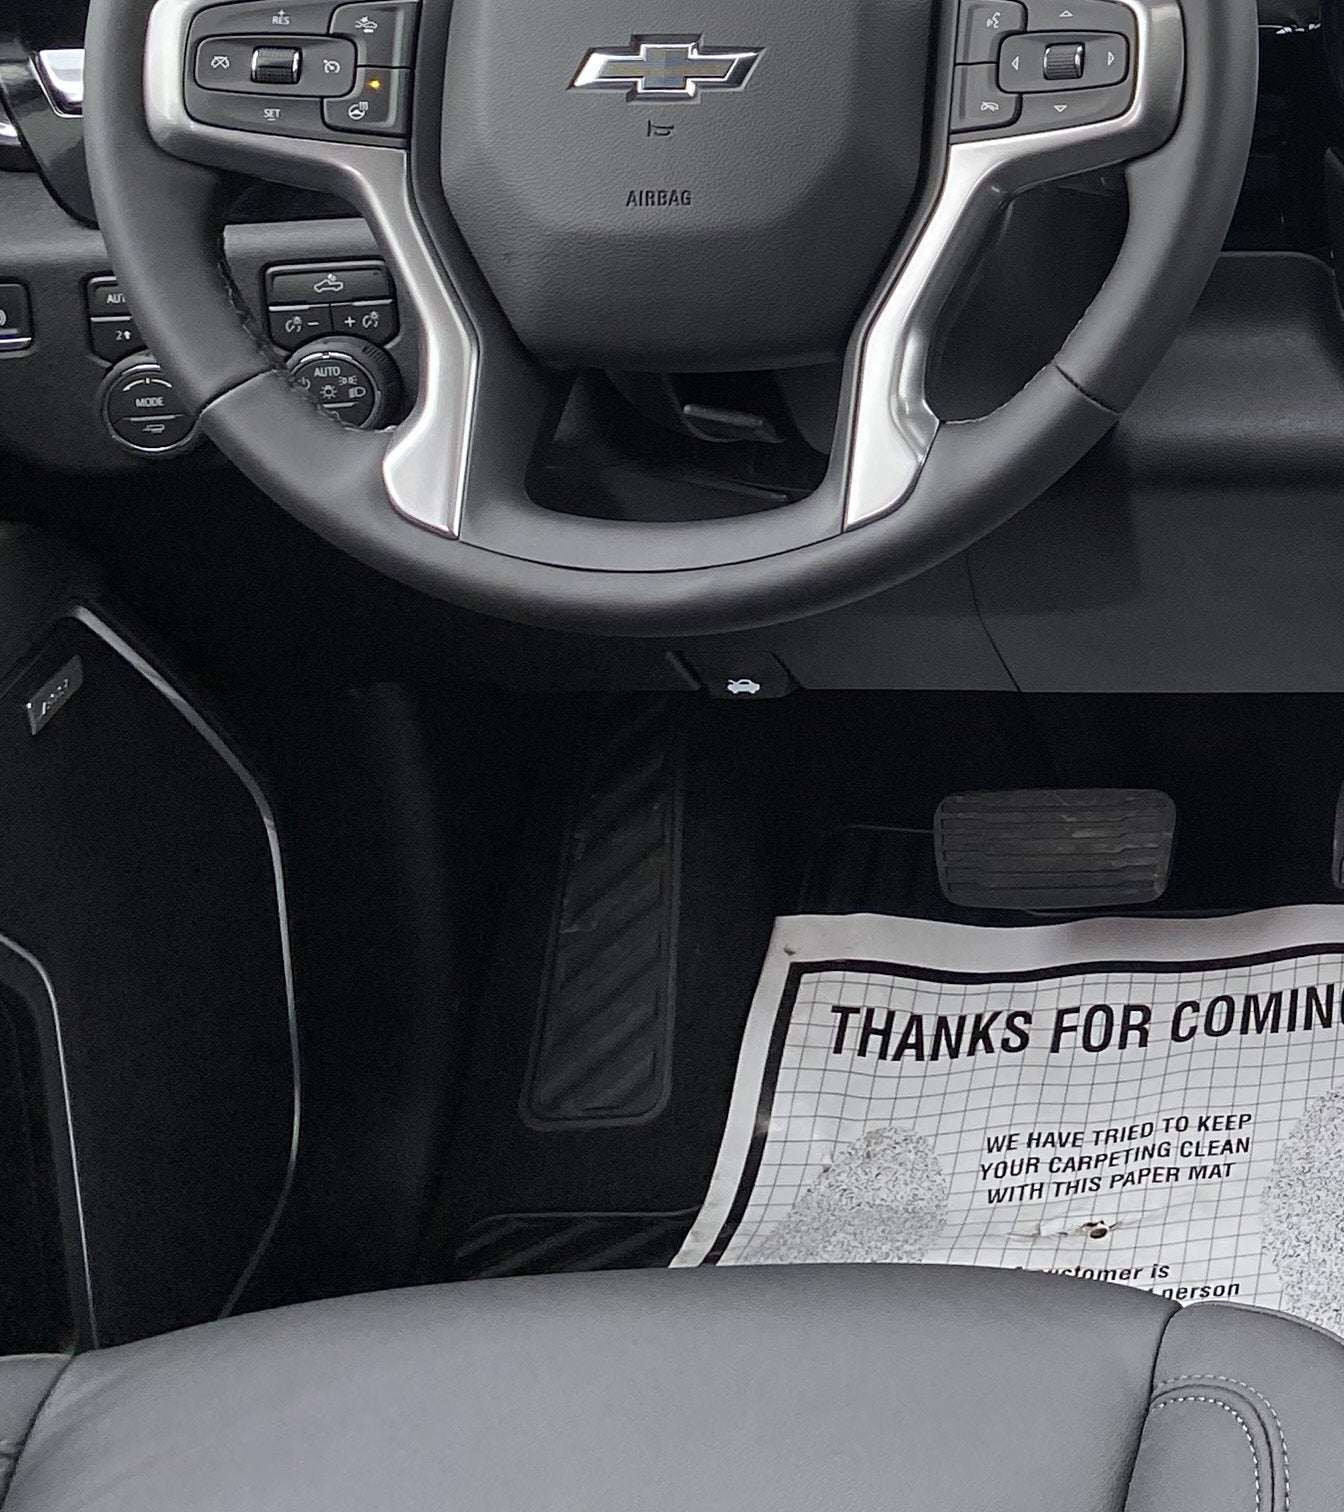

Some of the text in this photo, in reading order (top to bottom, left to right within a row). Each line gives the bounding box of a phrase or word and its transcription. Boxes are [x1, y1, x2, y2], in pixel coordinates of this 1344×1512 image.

[272, 16, 290, 25] RES
[264, 108, 281, 118] SET
[626, 190, 691, 207] AIRBAG
[314, 366, 340, 377] AUTO
[136, 397, 165, 407] MODE
[830, 1005, 1033, 1062] THANKS
[1049, 1004, 1151, 1055] FOR
[986, 1113, 1252, 1154] WE HAVE TRIED TO KEEP
[980, 1137, 1250, 1181] YOUR CARPETING CLEAN
[987, 1162, 1236, 1204] WITH THIS PAPER MAT
[1150, 1263, 1170, 1280] is
